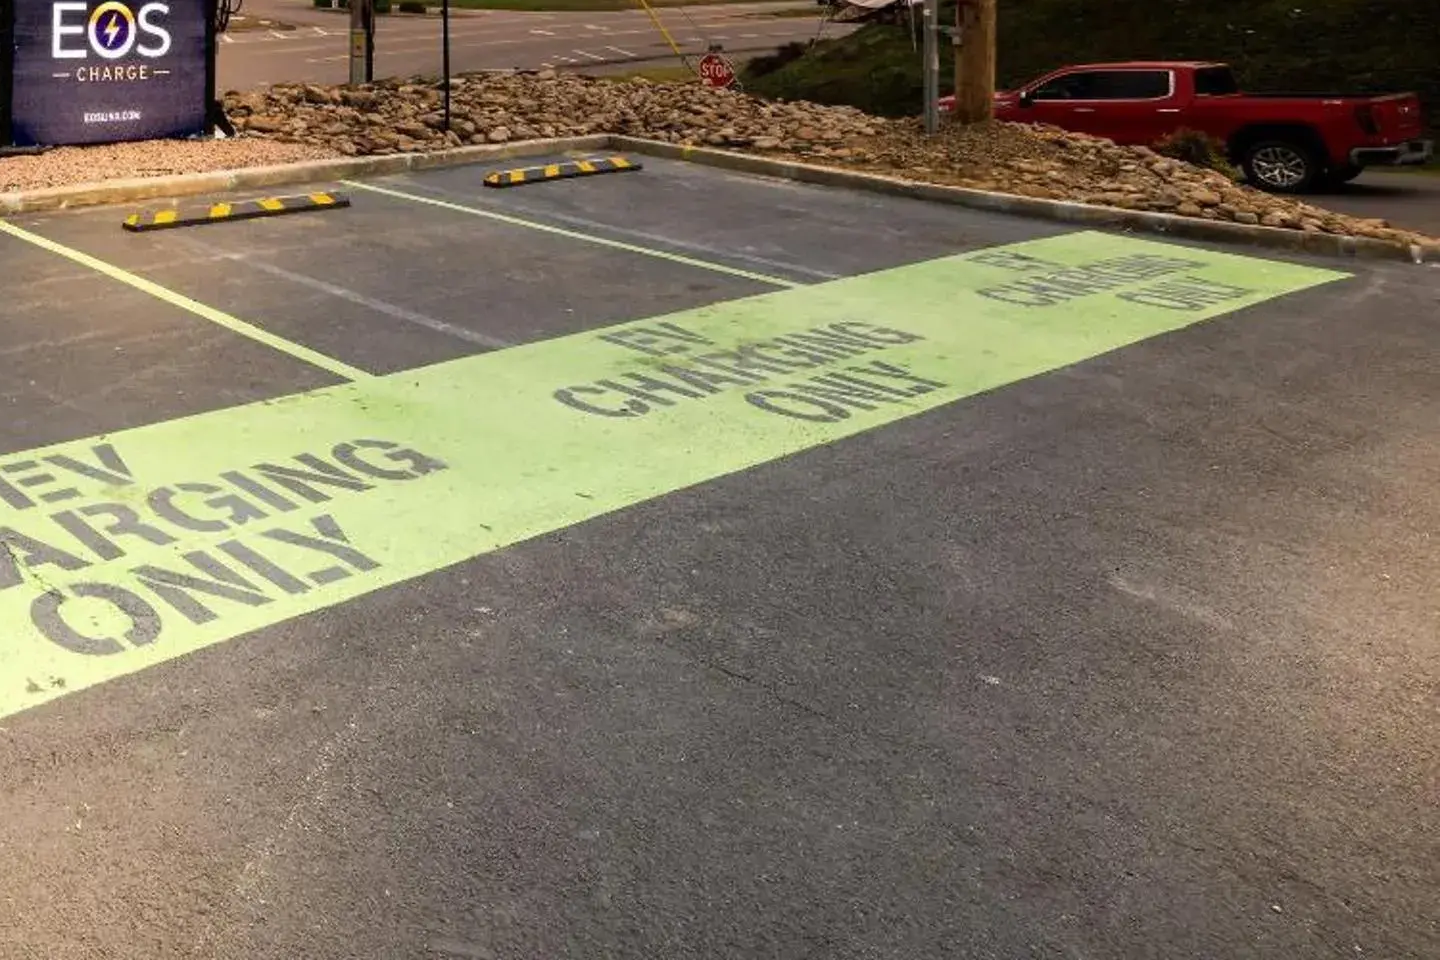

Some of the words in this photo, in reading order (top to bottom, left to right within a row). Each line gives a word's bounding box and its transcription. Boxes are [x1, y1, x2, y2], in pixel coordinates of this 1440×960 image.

[52, 1, 171, 58] EOS
[76, 65, 148, 81] CHARGE
[702, 63, 729, 77] STOP
[596, 322, 715, 357] EV
[552, 321, 926, 417] CHARGING
[745, 360, 948, 423] ONLY
[30, 514, 382, 656] ONLY
